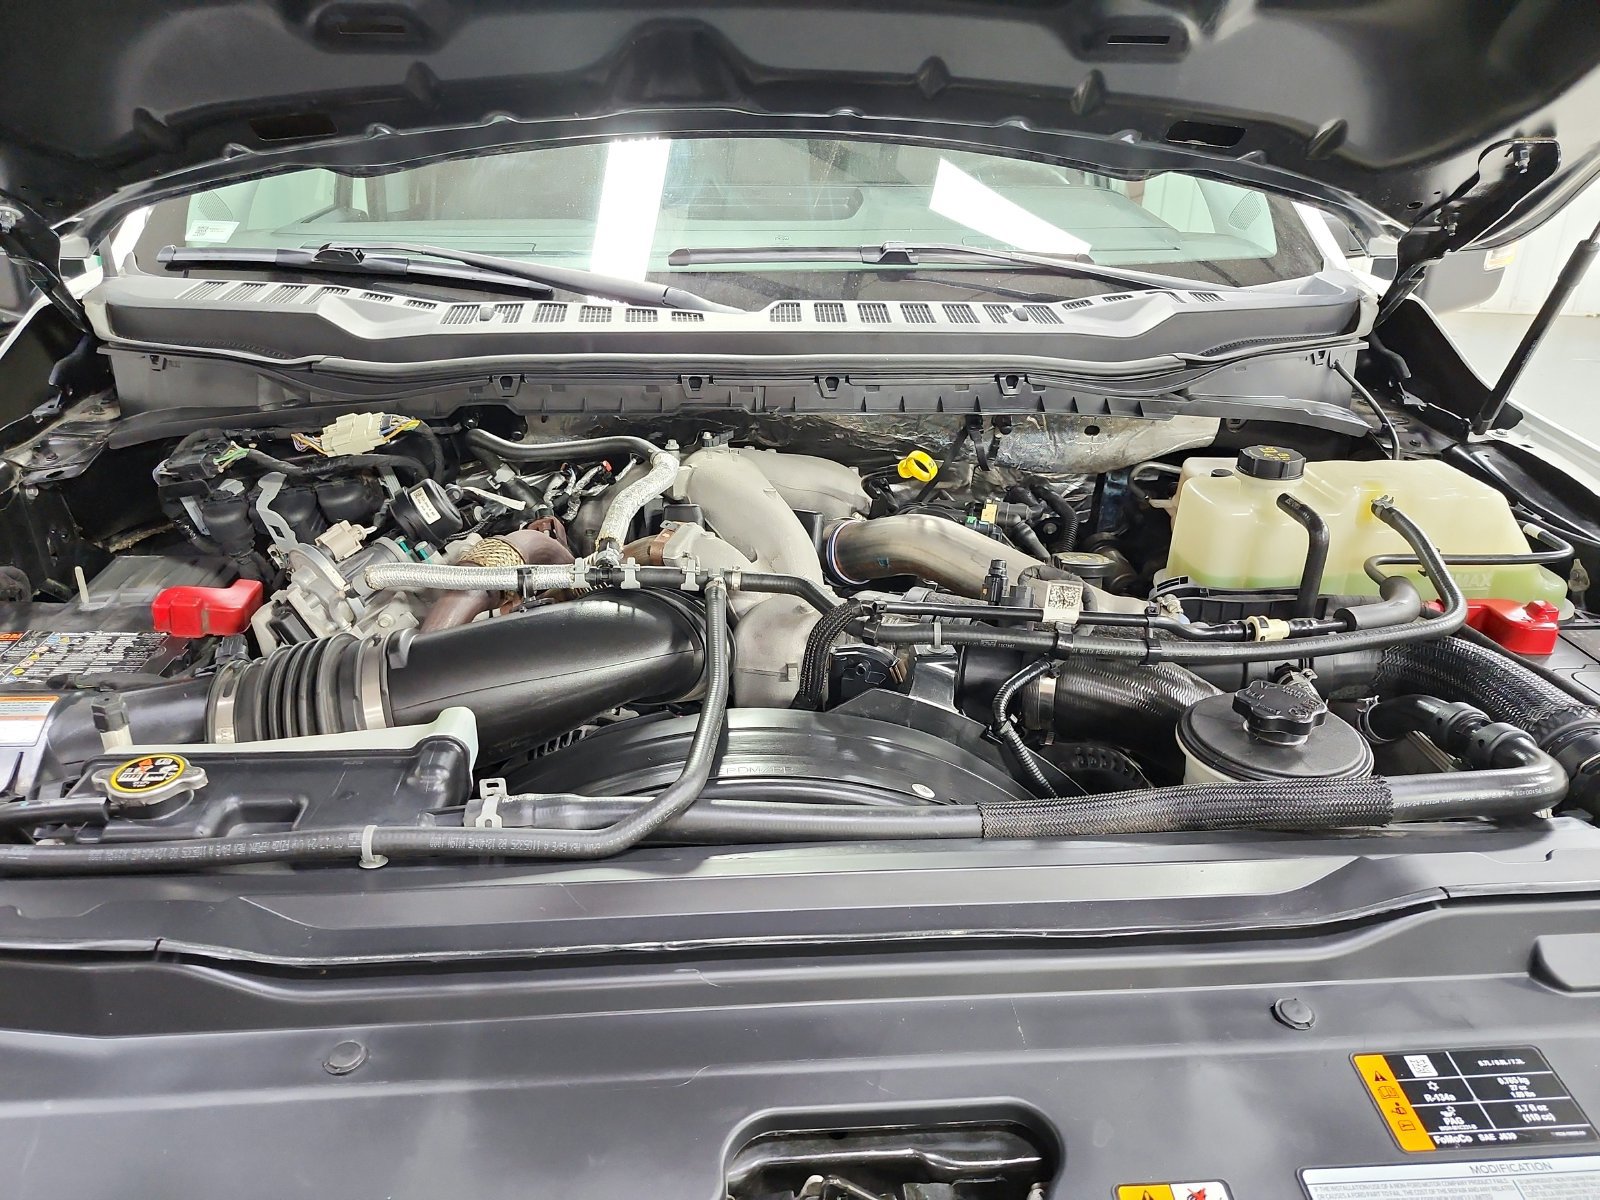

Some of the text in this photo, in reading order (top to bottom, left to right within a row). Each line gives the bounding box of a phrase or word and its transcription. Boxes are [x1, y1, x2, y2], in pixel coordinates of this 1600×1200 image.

[1517, 1075, 1530, 1085] kg
[1423, 1092, 1457, 1103] R-134a
[1515, 1104, 1529, 1112] 3.7
[1528, 1103, 1537, 1112] fl
[1442, 1116, 1465, 1126] PAG
[1522, 1112, 1556, 1123] (110 cc)
[1432, 1133, 1474, 1144] FoMoCo
[1477, 1133, 1497, 1142] SAE
[1469, 1161, 1553, 1175] MODIFICATION
